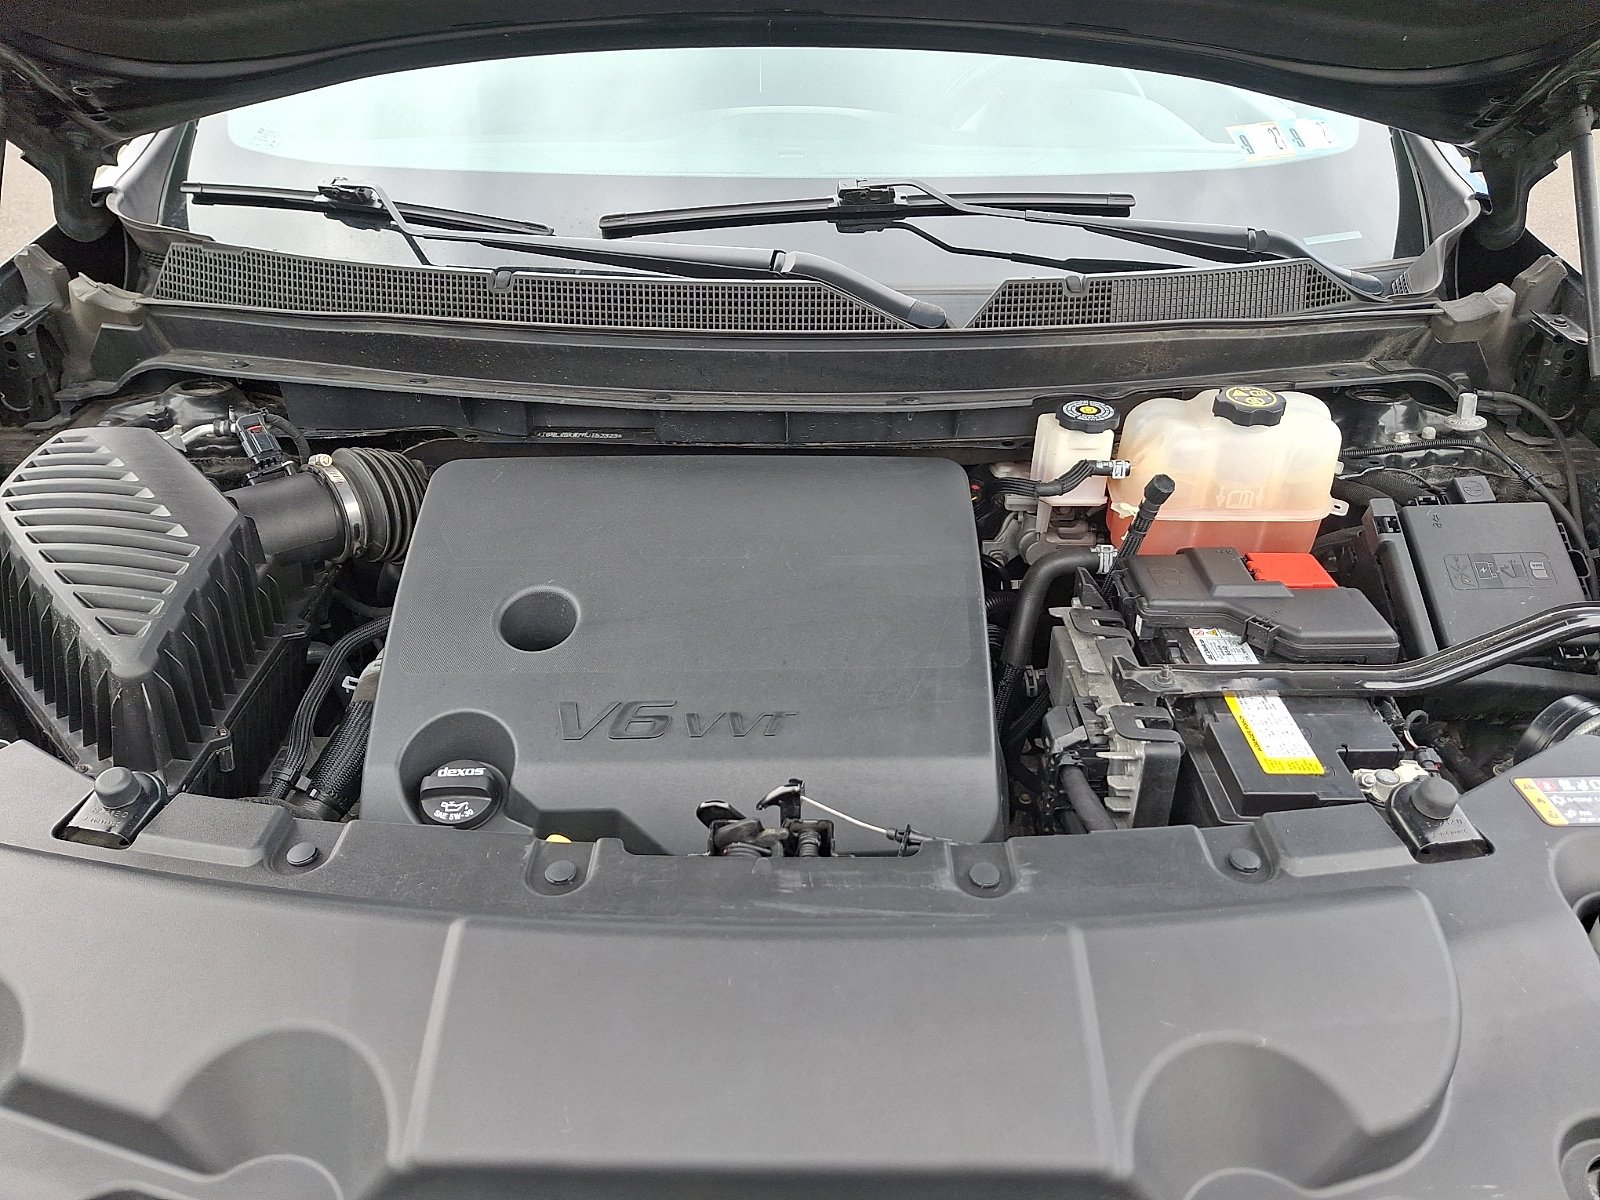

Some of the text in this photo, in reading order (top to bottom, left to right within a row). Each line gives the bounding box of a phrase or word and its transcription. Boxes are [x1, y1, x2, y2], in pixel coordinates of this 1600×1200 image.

[558, 700, 797, 740] V6 VVT
[437, 767, 487, 777] dexos
[433, 808, 474, 821] SAE 5W-30
